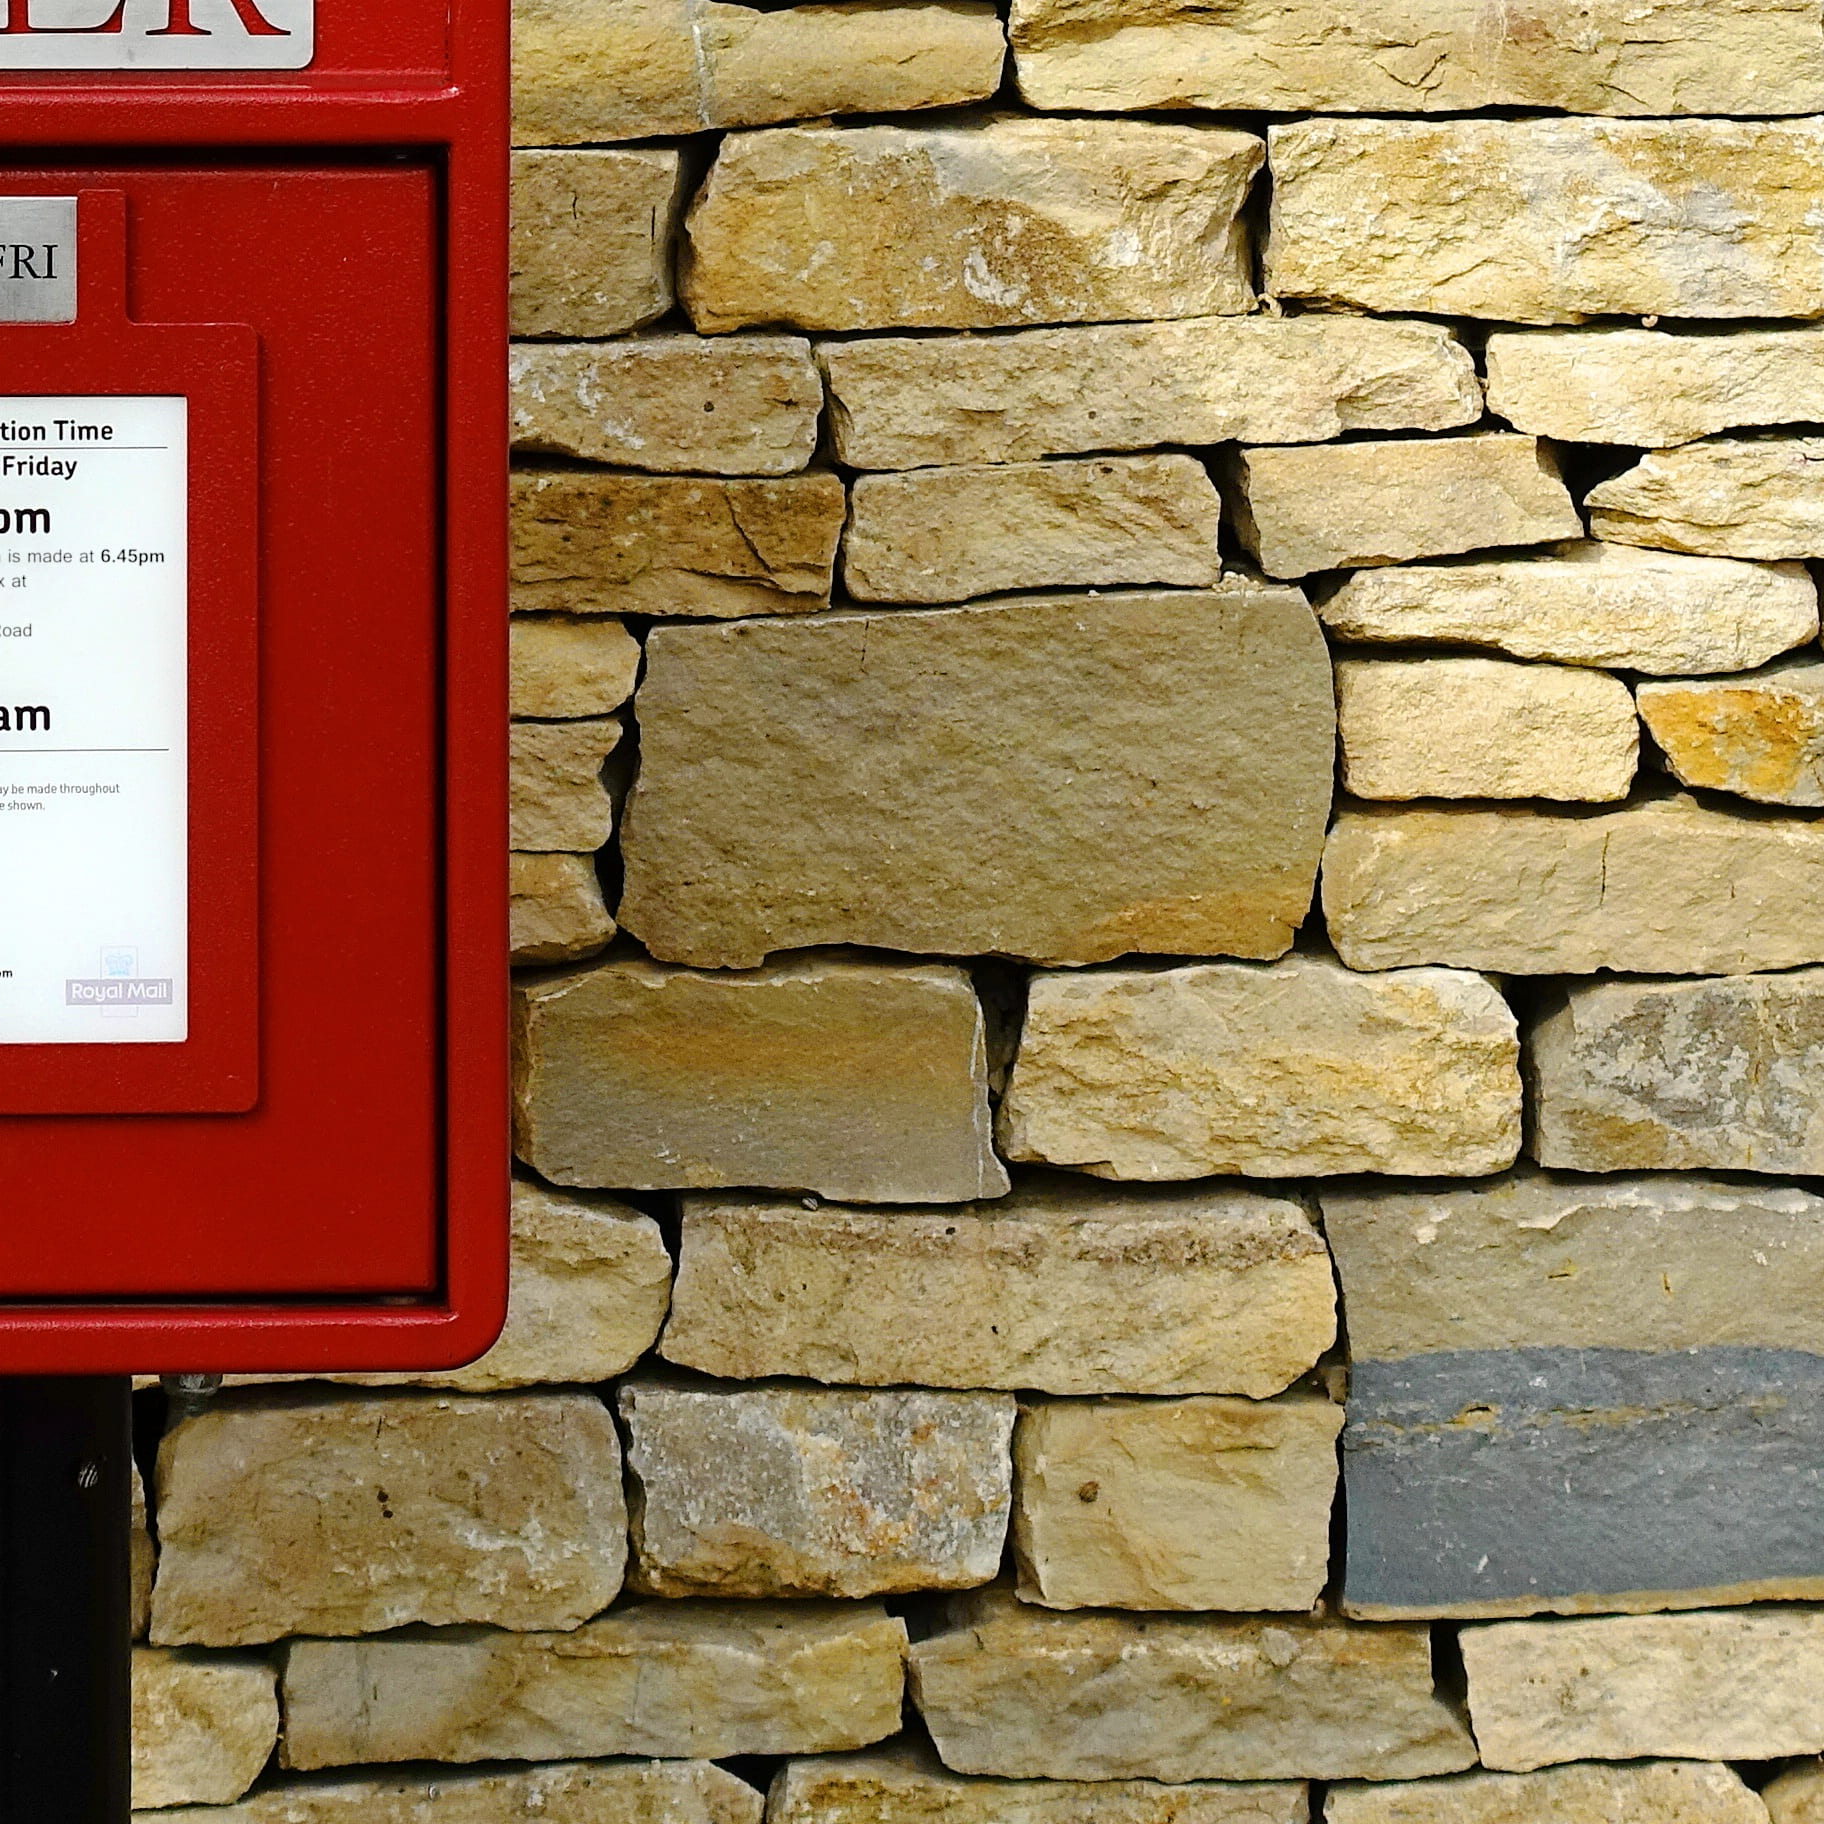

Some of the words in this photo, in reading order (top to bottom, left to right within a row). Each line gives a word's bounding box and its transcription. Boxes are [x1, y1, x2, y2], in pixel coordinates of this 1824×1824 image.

[53, 419, 113, 441] Time
[3, 455, 78, 480] Friday
[9, 549, 20, 563] is
[28, 549, 72, 563] made
[80, 550, 94, 563] at
[101, 549, 164, 566] 6.45pm
[12, 575, 26, 587] at
[11, 784, 24, 794] be
[27, 783, 57, 794] made
[60, 783, 120, 796] throughout
[8, 800, 45, 810] shown.
[71, 983, 122, 1002] Royal
[127, 983, 167, 999] Mail
